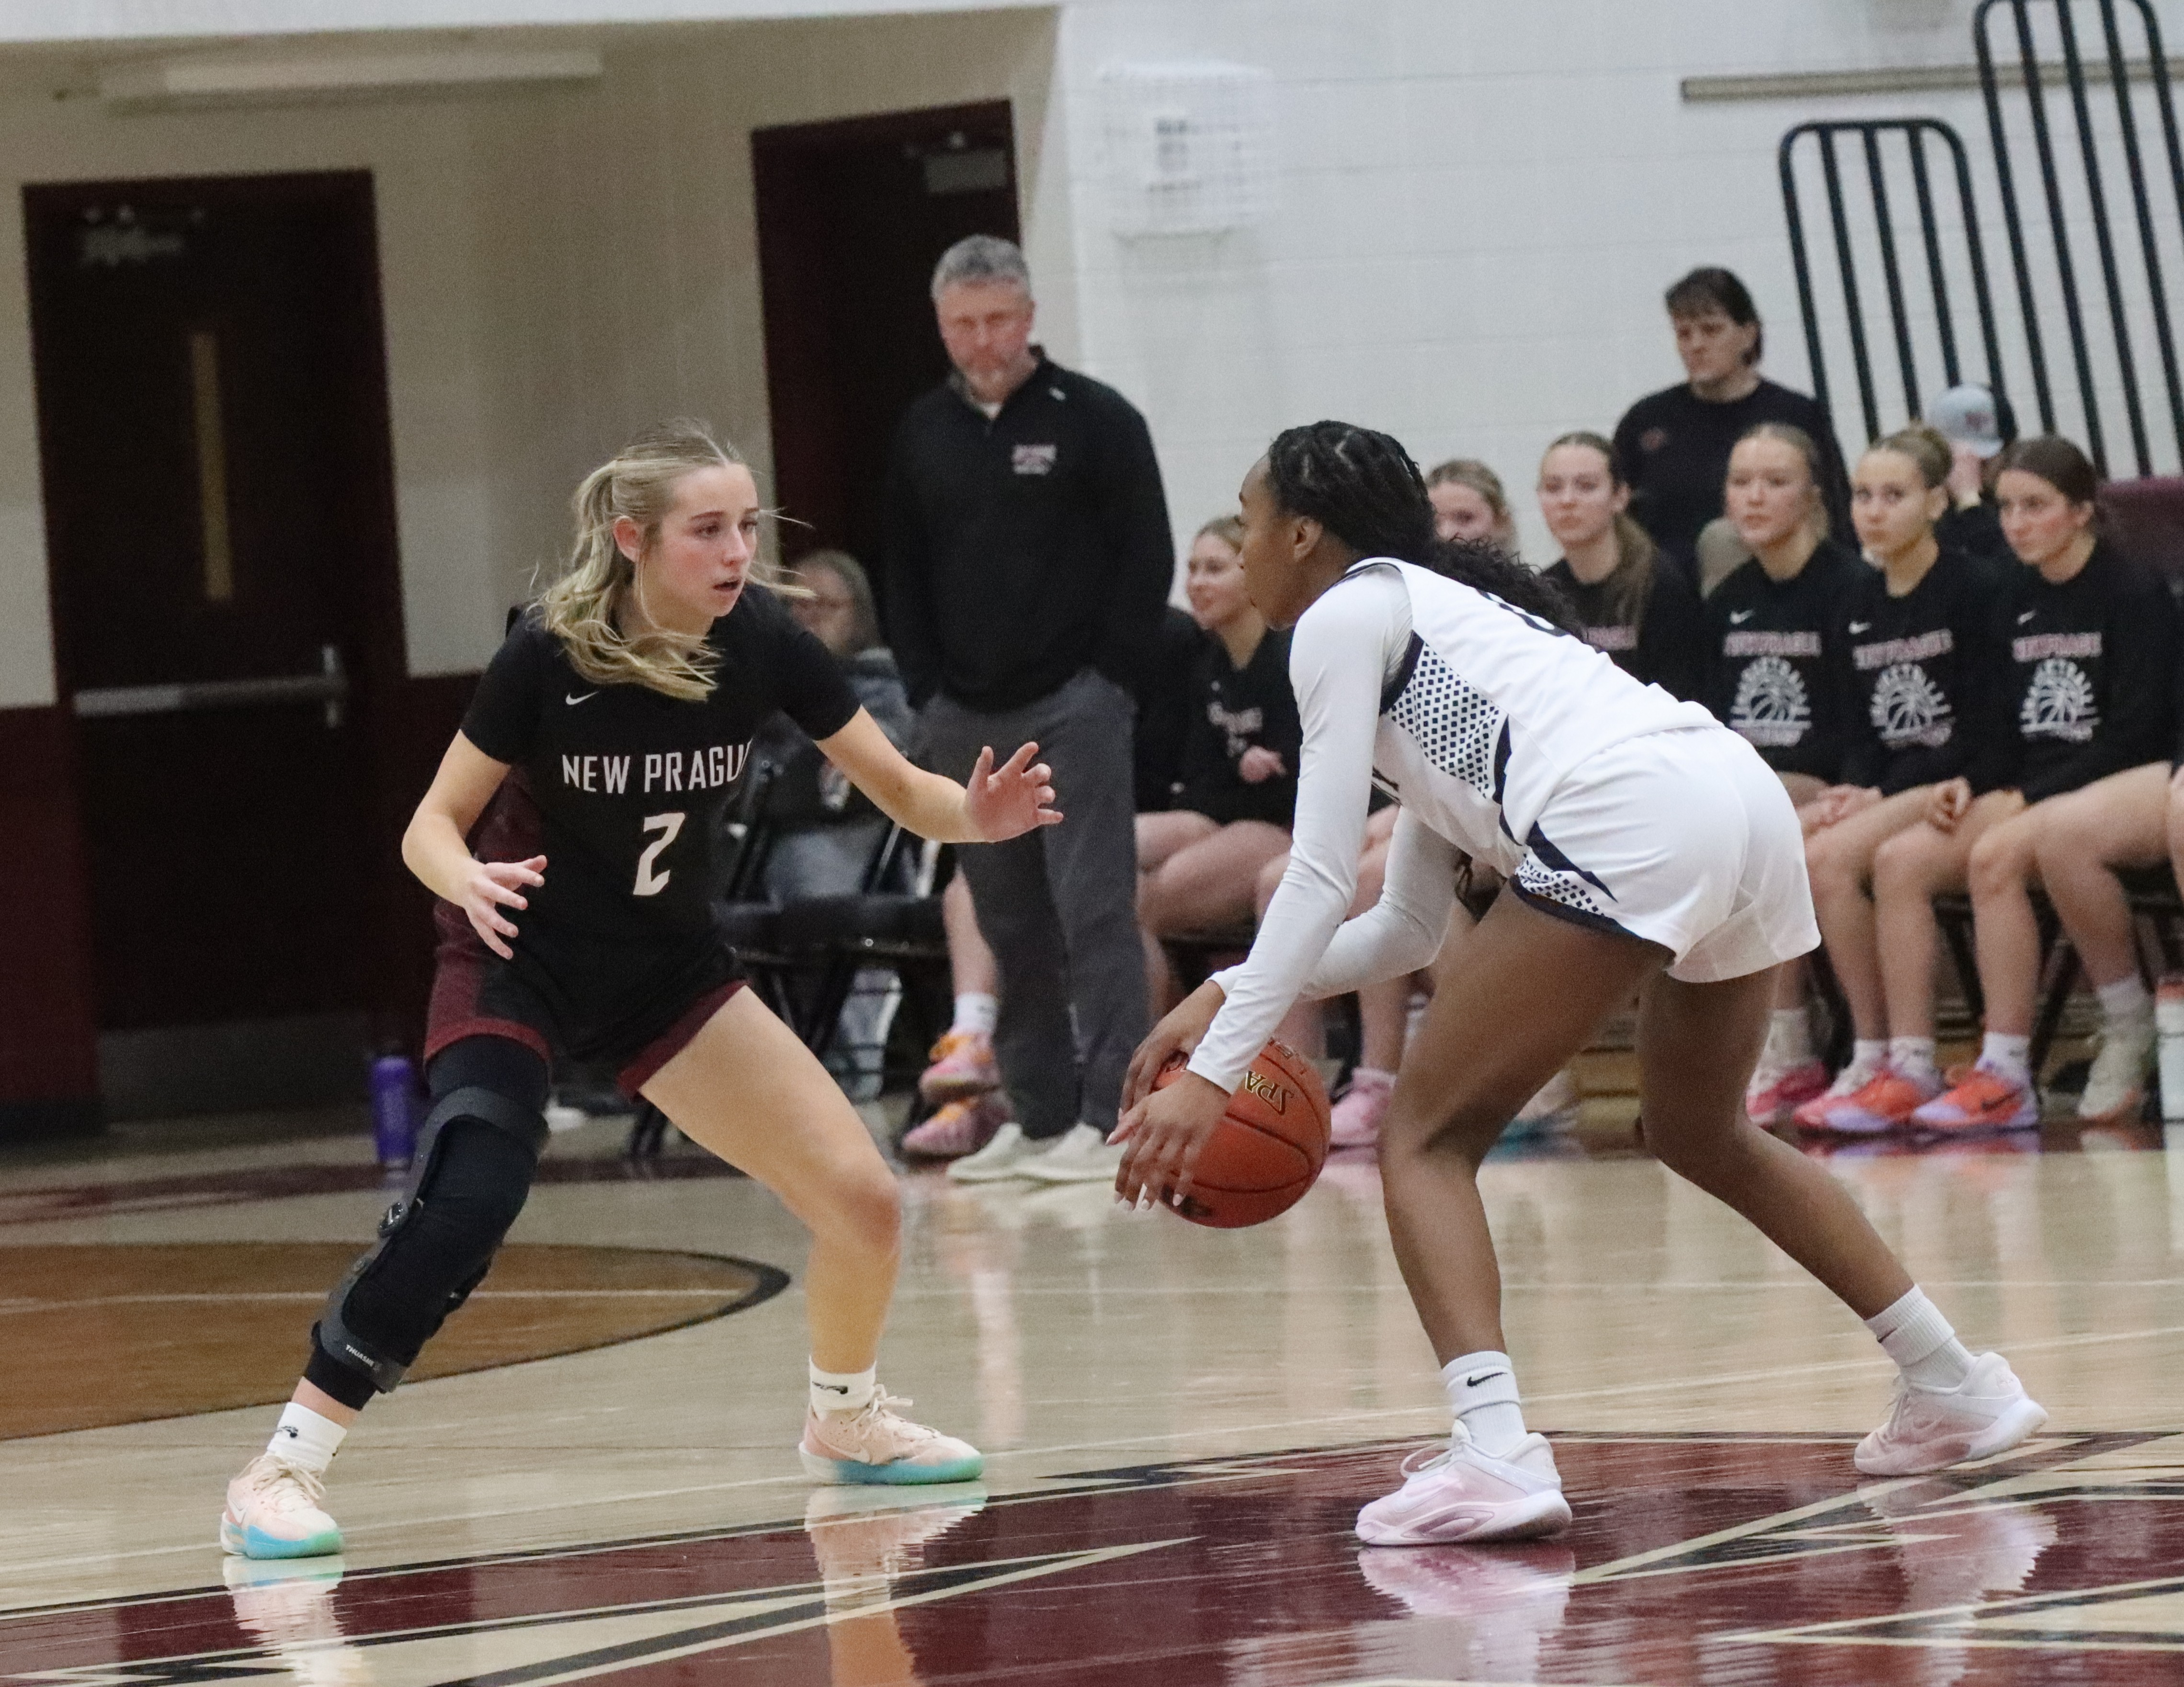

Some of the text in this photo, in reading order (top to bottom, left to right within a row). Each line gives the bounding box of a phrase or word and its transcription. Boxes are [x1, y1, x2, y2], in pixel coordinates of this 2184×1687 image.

[562, 737, 752, 794] NEW PRAGU
[633, 812, 685, 896] 2
